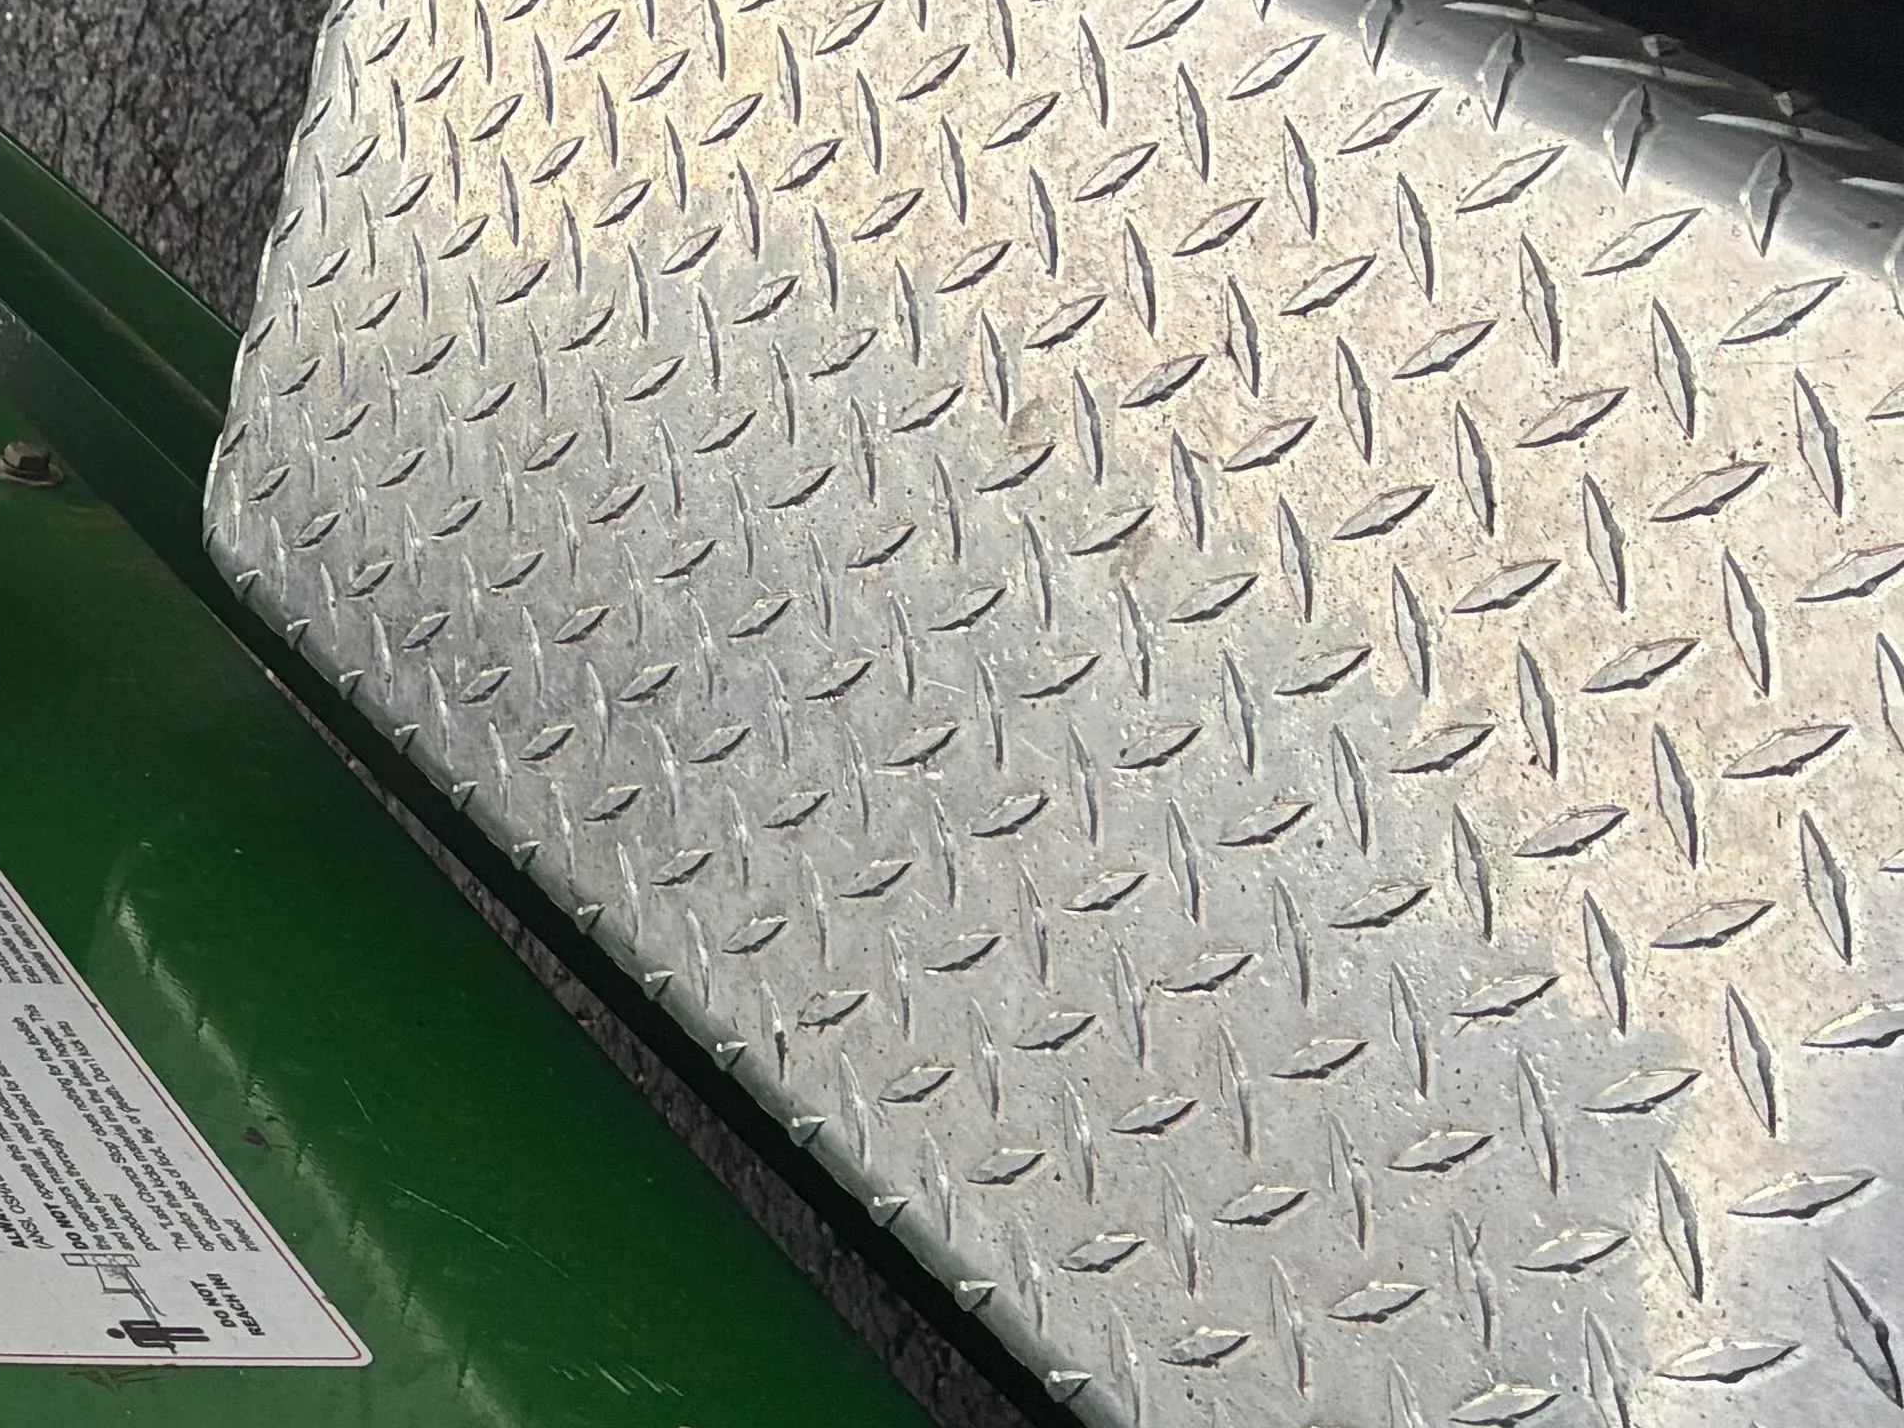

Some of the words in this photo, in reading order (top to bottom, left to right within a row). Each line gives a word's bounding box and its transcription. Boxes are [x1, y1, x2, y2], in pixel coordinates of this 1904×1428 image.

[3, 1144, 29, 1161] this
[16, 1164, 58, 1200] operate
[43, 1203, 75, 1228] NOT
[63, 1232, 90, 1250] DO
[204, 1273, 231, 1290] IN!
[189, 1281, 222, 1307] NOT
[210, 1310, 237, 1328] DO
[220, 1294, 266, 1336] REACH
